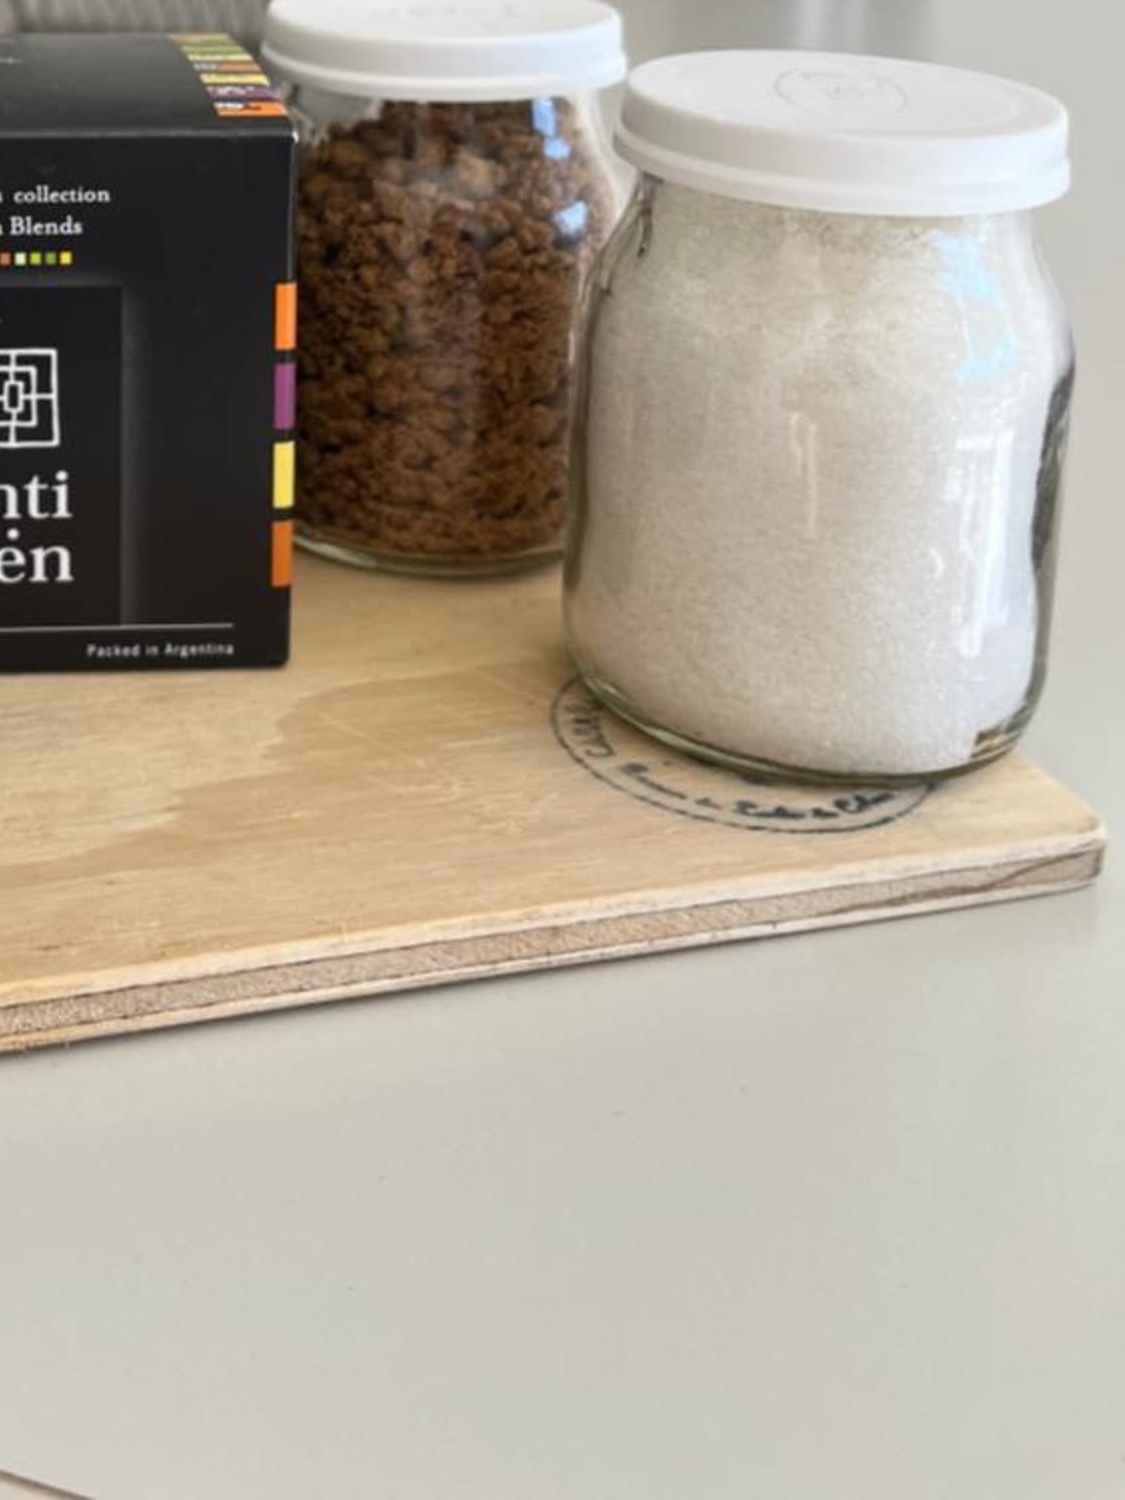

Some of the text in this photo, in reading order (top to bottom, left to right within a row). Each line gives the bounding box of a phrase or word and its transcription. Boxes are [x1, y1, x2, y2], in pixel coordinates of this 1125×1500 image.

[13, 184, 111, 203] collection
[9, 214, 84, 236] Blends
[86, 641, 234, 659] Packed in Argentina
